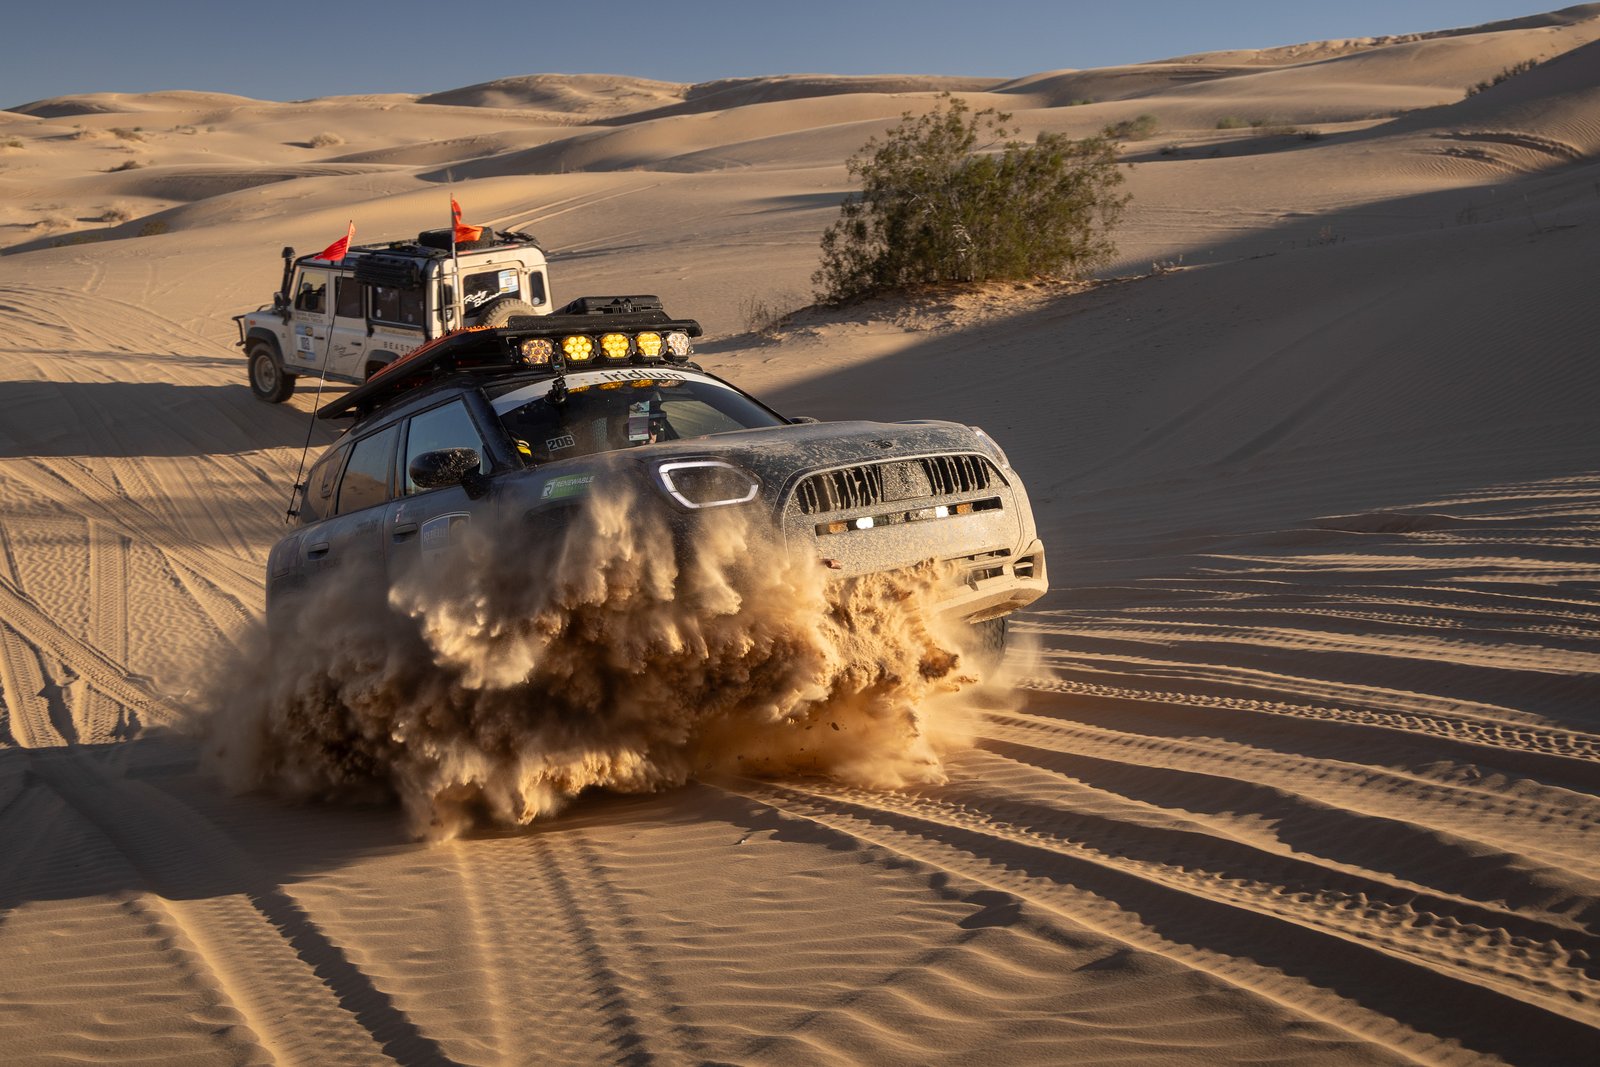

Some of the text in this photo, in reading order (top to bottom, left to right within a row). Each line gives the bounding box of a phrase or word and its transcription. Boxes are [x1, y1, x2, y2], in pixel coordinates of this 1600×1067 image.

[601, 369, 686, 381] iridium
[547, 437, 574, 450] 206
[555, 475, 595, 488] RENEWABLE
